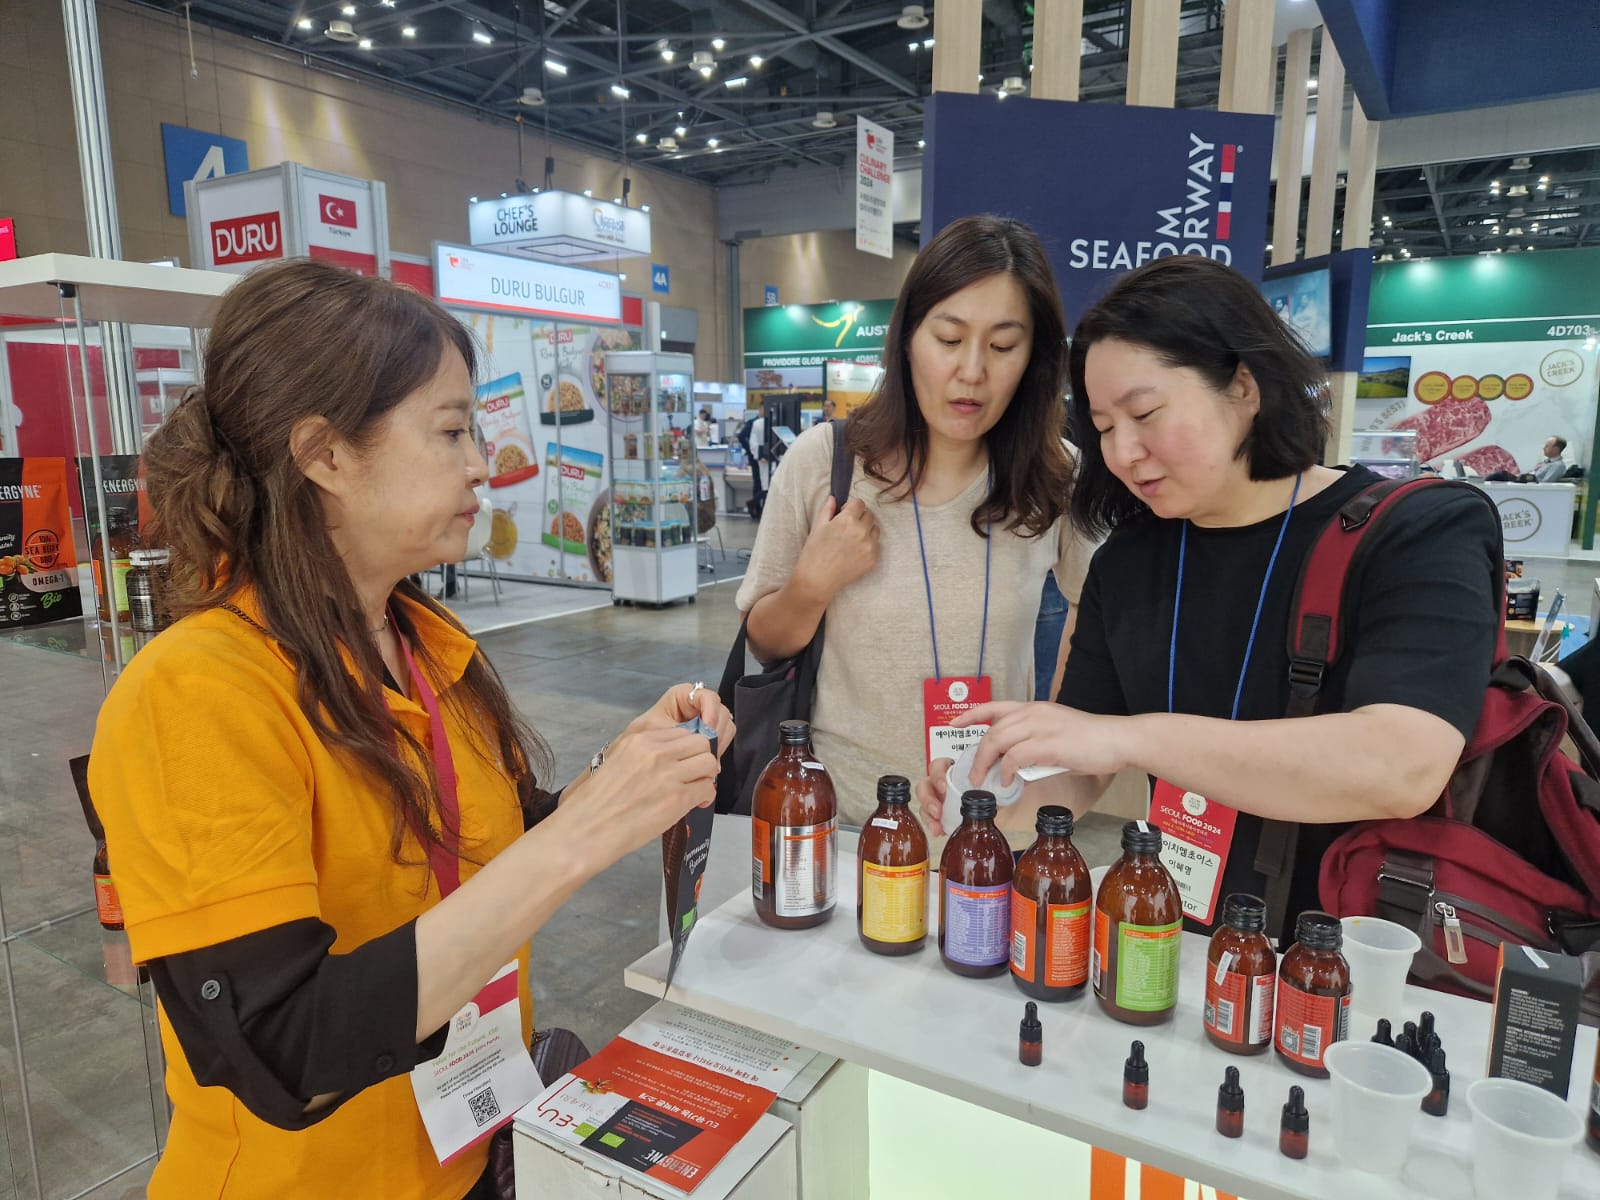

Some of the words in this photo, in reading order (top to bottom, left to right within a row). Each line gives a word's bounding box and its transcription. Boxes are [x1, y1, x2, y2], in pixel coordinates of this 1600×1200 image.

[859, 163, 891, 184] CHALLENGE
[497, 204, 534, 222] CHEF'S
[494, 218, 539, 236] LOUNGE
[216, 221, 277, 258] DURU
[653, 271, 668, 287] 4A
[491, 277, 531, 299] DURU
[535, 284, 585, 307] BULGUR
[1392, 331, 1433, 343] Jack's
[1435, 329, 1474, 342] Creek
[1546, 325, 1590, 338] 4D703
[762, 358, 801, 367] PROVIDORE
[487, 396, 509, 412] DURU
[561, 465, 584, 480] DURU
[1503, 510, 1532, 521] ACK'S
[1503, 519, 1533, 529] REEK
[25, 544, 39, 555] SEA
[40, 593, 63, 609] Bio
[933, 703, 951, 711] SEOUL
[1160, 805, 1181, 819] SEOUL
[1182, 814, 1203, 828] FOOD
[1203, 822, 1222, 836] 2024
[1162, 840, 1214, 867] 이치엠초이스
[704, 1119, 720, 1129] EU
[644, 1149, 699, 1179] ENERGYNE
